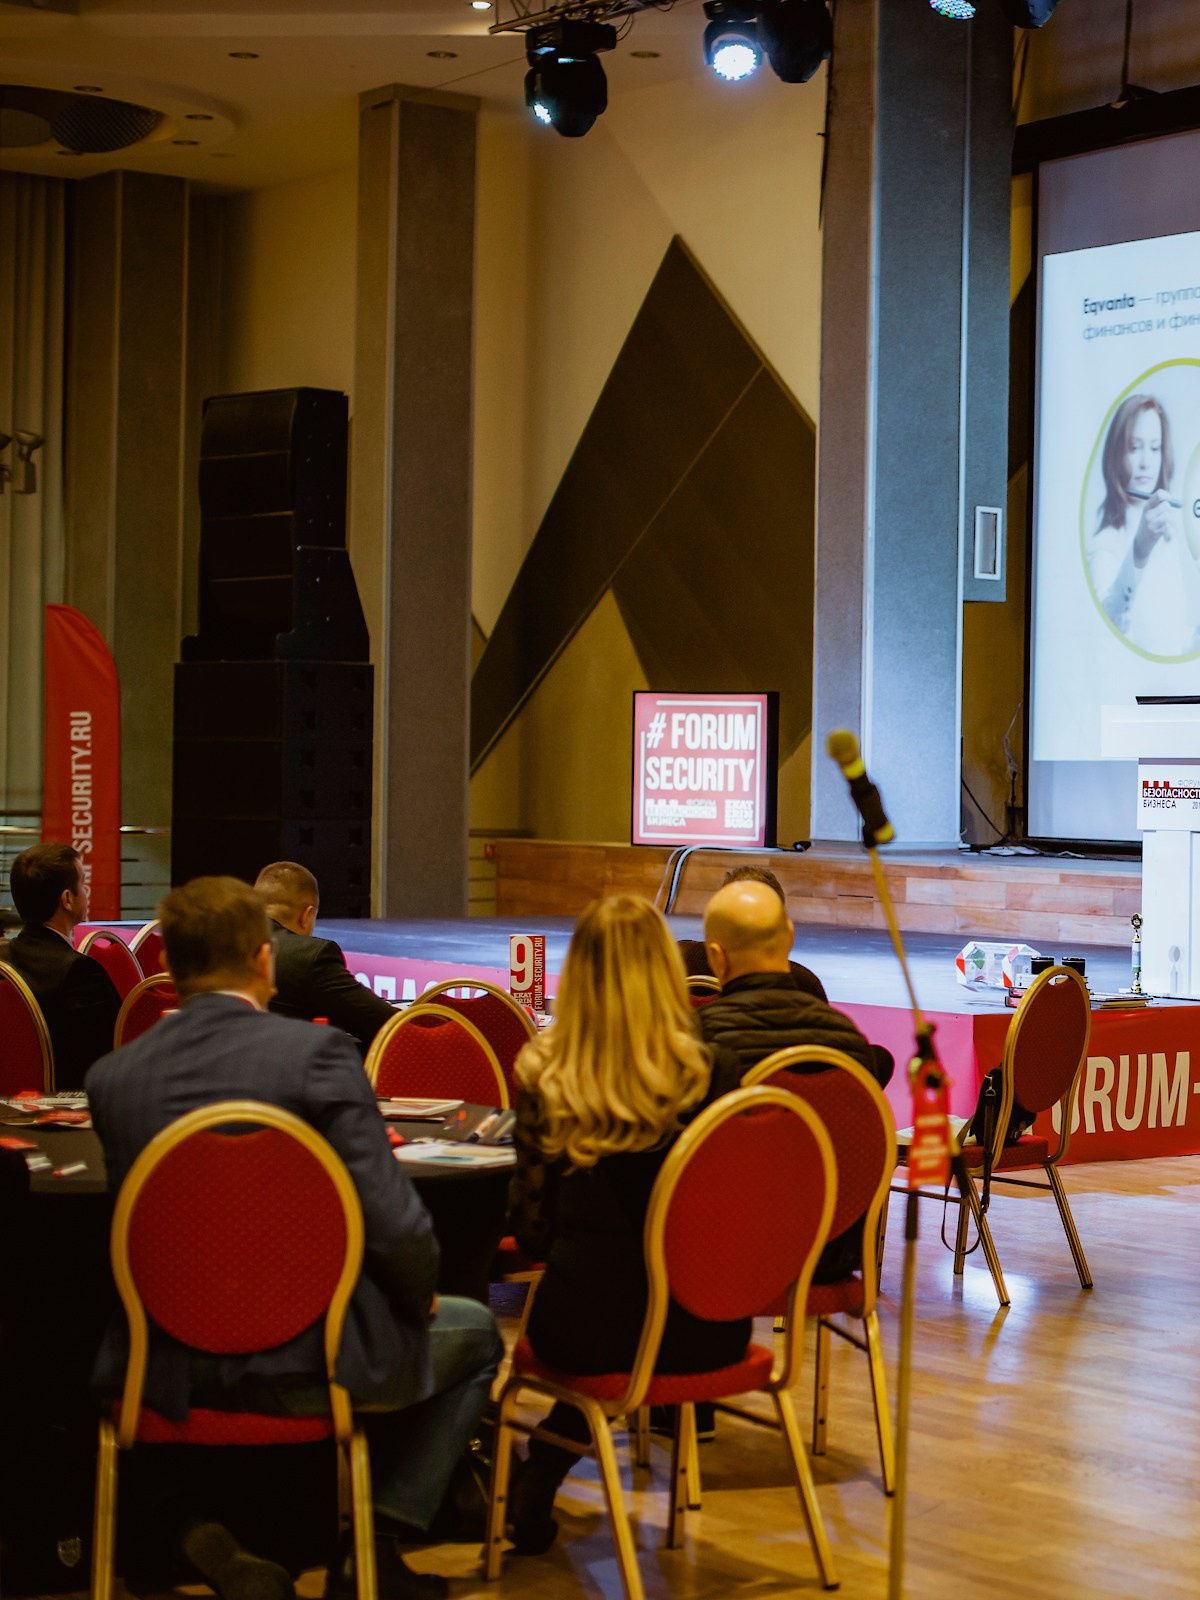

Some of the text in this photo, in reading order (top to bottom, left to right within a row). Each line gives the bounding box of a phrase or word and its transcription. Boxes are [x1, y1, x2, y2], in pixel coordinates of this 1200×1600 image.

[1083, 293, 1135, 315] Eqvanta
[1083, 318, 1152, 341] финансов
[1157, 318, 1165, 329] и
[671, 712, 756, 750] FORUM
[645, 756, 755, 792] SECURITY
[1143, 799, 1176, 809] БИЗНЕСА
[511, 936, 533, 991] 9
[534, 938, 543, 1011] FORUM-SECURITY.RU
